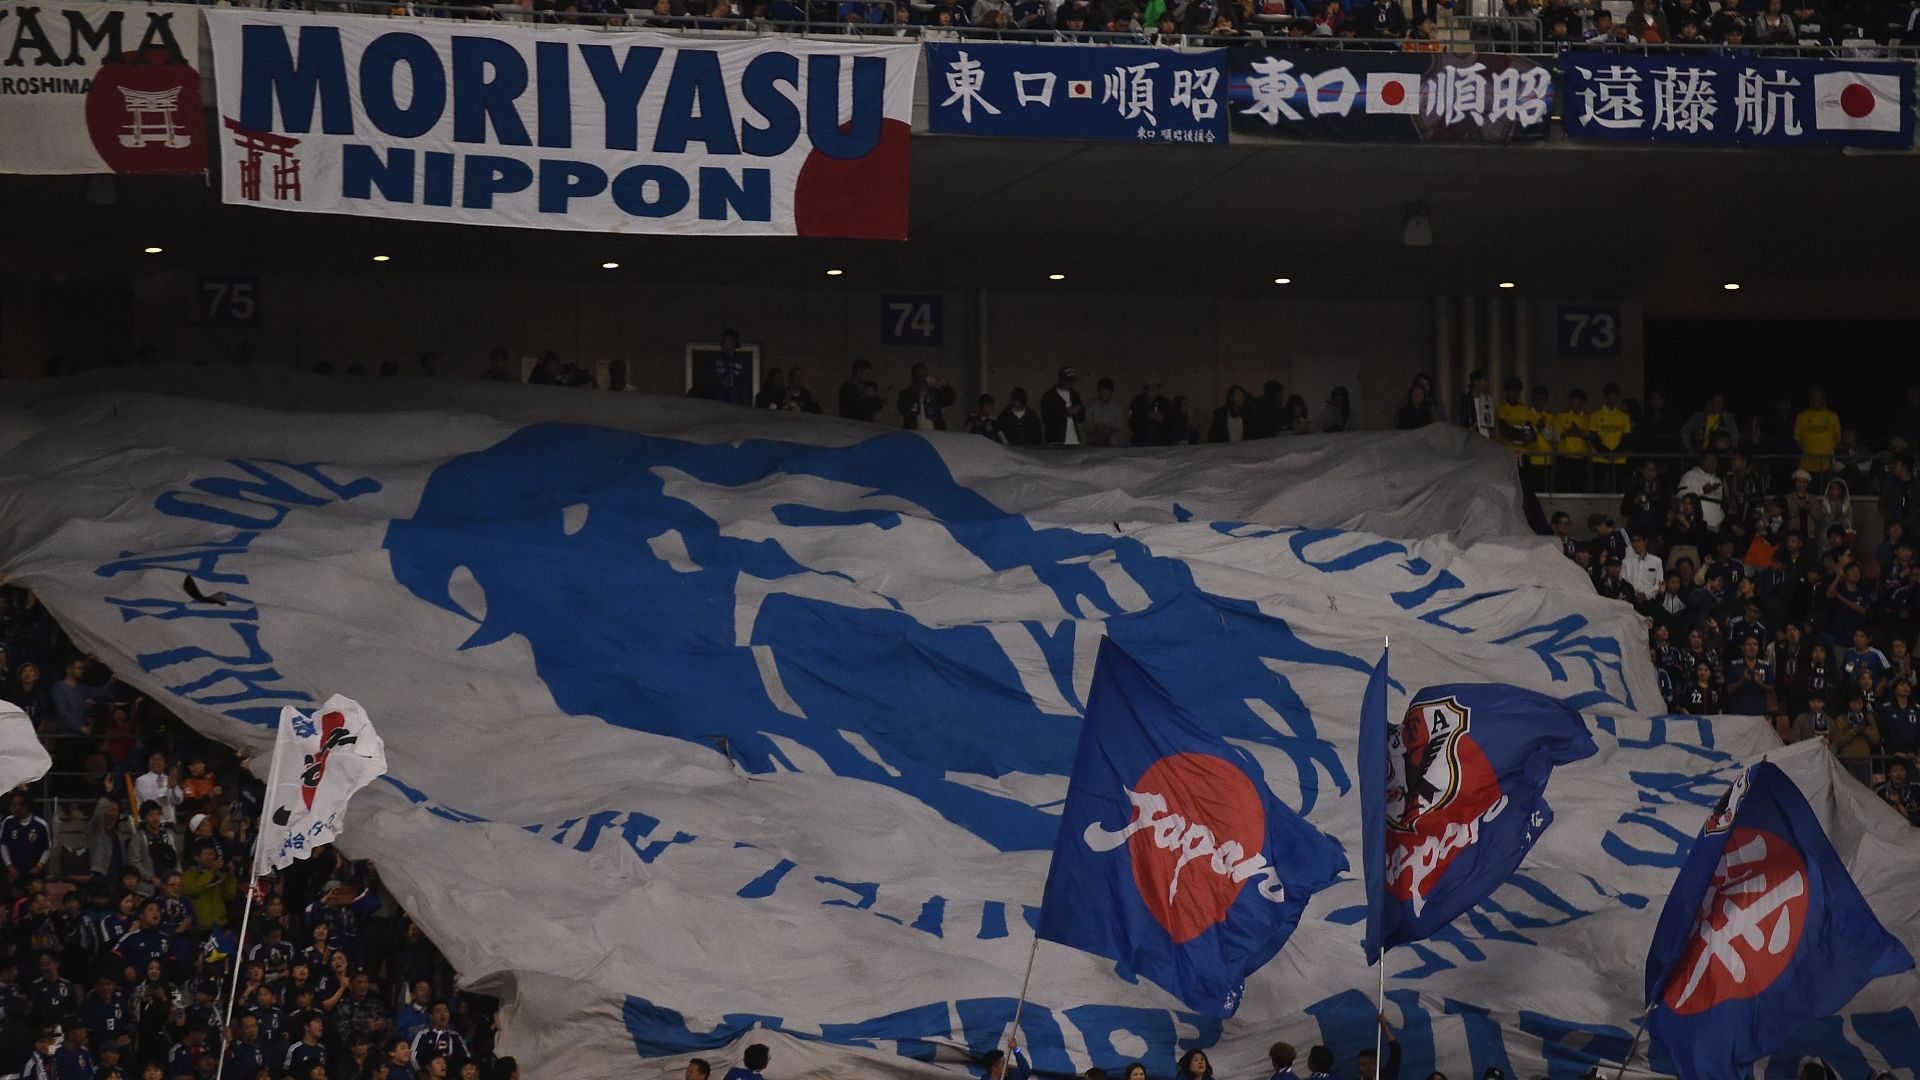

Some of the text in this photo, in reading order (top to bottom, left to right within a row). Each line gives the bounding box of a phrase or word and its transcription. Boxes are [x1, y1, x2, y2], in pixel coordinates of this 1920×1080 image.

[239, 25, 886, 160] MORIYASU
[940, 51, 1220, 126] 東口 順昭
[1240, 56, 1551, 128] 東口 順昭
[1575, 65, 1803, 136] 遠藤航
[343, 144, 771, 221] NIPPON
[203, 283, 256, 319] 75
[888, 303, 935, 337] 74
[1564, 314, 1616, 348] 73
[1691, 692, 1702, 704] 22
[1083, 784, 1285, 906] Japan
